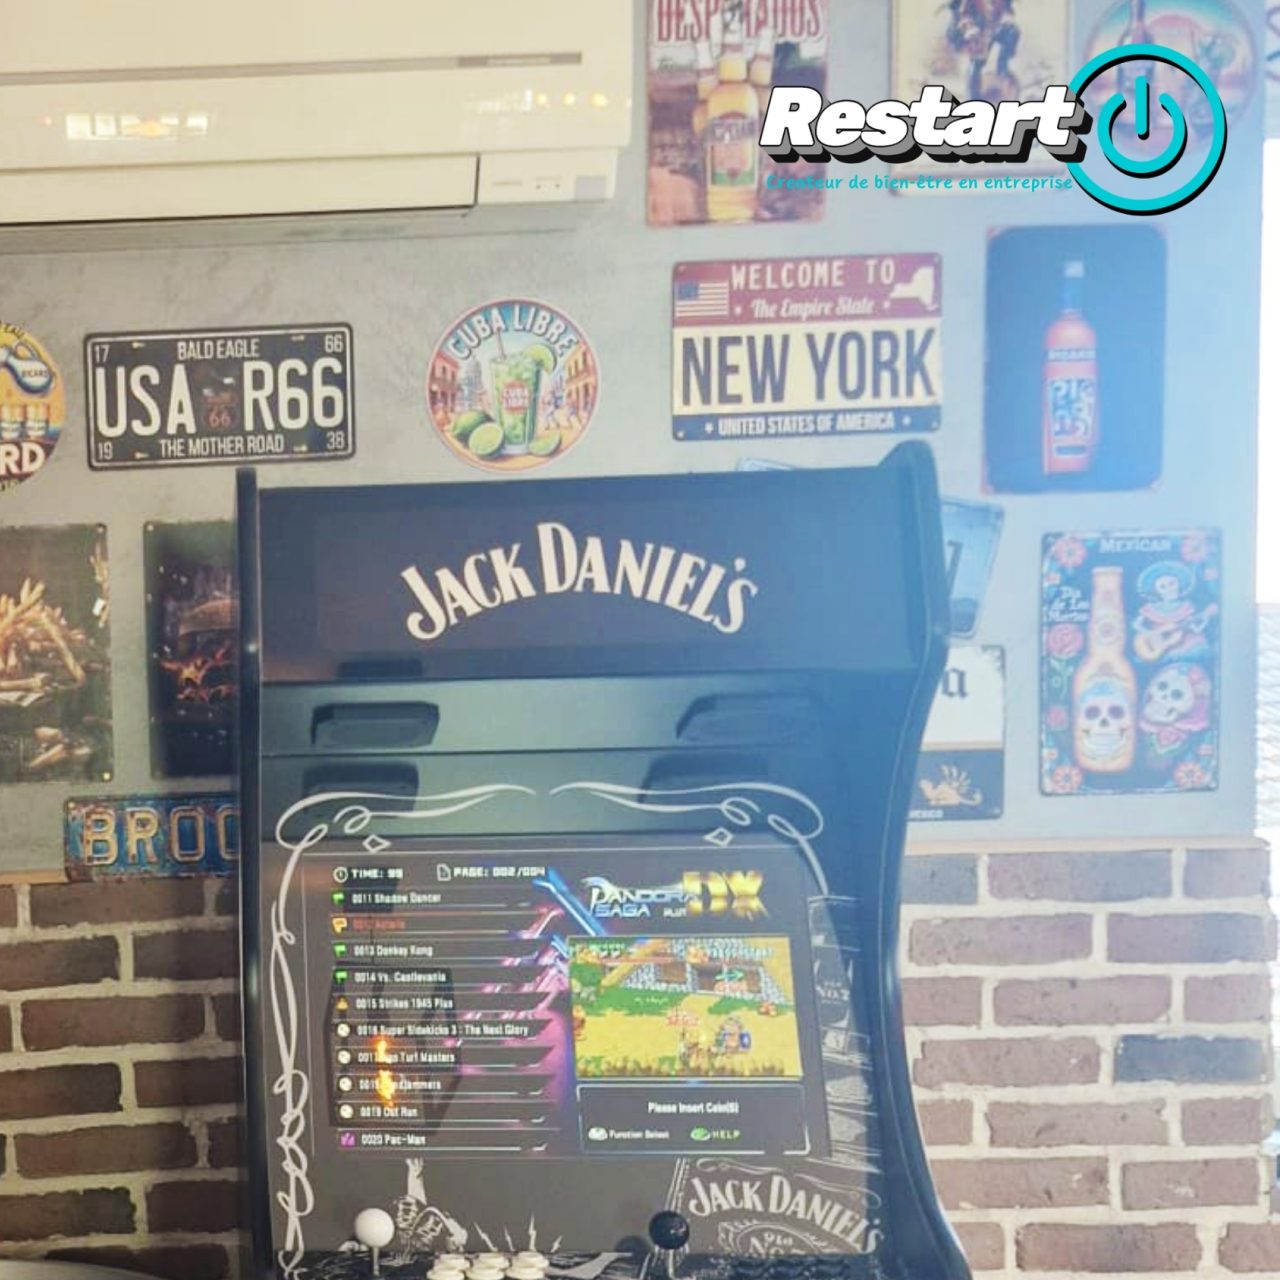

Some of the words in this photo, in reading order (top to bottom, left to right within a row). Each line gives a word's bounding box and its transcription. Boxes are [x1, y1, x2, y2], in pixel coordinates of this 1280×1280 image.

[731, 259, 846, 292] WELCOME
[866, 257, 896, 285] TO
[751, 298, 777, 318] The
[779, 297, 832, 322] Empire
[834, 295, 875, 317] State
[324, 334, 344, 354] 66
[447, 306, 509, 360] CUBA
[512, 303, 579, 359] LIBRE
[94, 344, 111, 364] 17
[177, 341, 215, 362] BALD
[216, 338, 261, 360] EAGLE
[682, 333, 791, 407] NEW
[805, 327, 937, 402] YORK
[95, 362, 197, 438] USA
[243, 356, 345, 433] R66
[208, 408, 232, 428] 66
[718, 417, 767, 437] UNITED
[767, 414, 816, 435] STATES
[817, 413, 835, 433] OF
[835, 411, 896, 432] AMERICA
[97, 441, 114, 461] 19
[160, 438, 188, 459] THE
[188, 436, 245, 458] MOTHER
[246, 433, 285, 455] ROAD
[326, 431, 346, 450] 38
[399, 542, 538, 641] JACK
[536, 521, 760, 635] DANIEL'S
[688, 1176, 766, 1218] JACK
[768, 1173, 886, 1256] DANIEL'S
